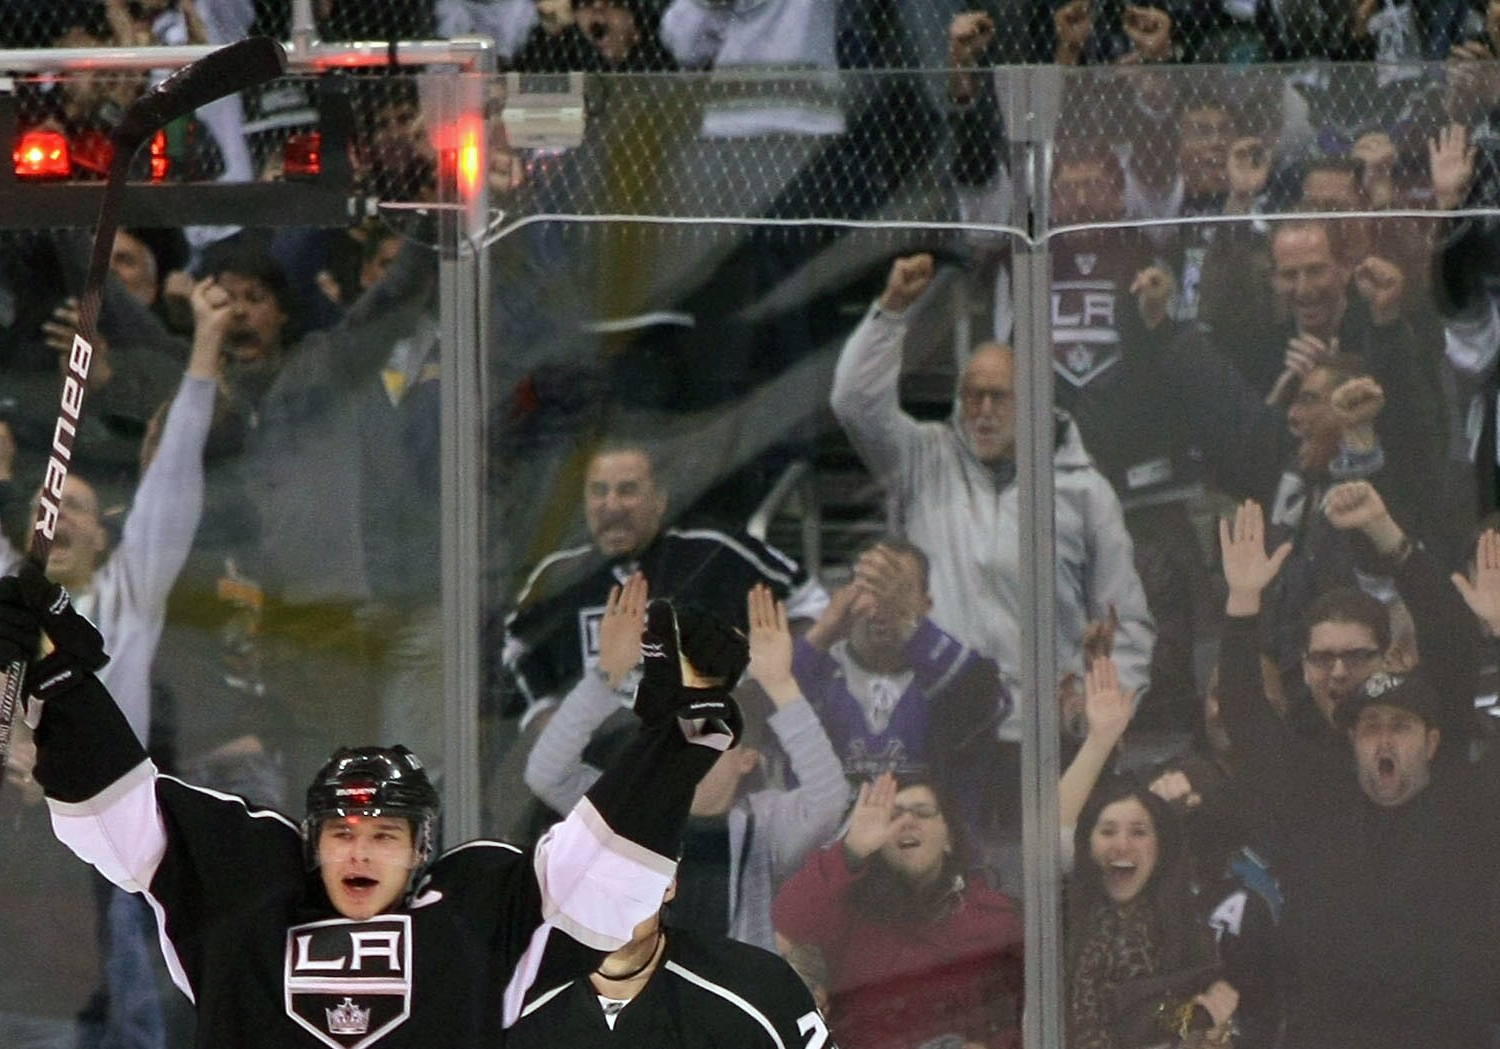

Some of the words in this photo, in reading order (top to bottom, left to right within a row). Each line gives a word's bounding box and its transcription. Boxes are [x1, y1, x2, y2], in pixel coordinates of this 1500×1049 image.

[1051, 291, 1116, 326] LA
[34, 333, 94, 541] BAUER
[294, 931, 402, 971] LA
